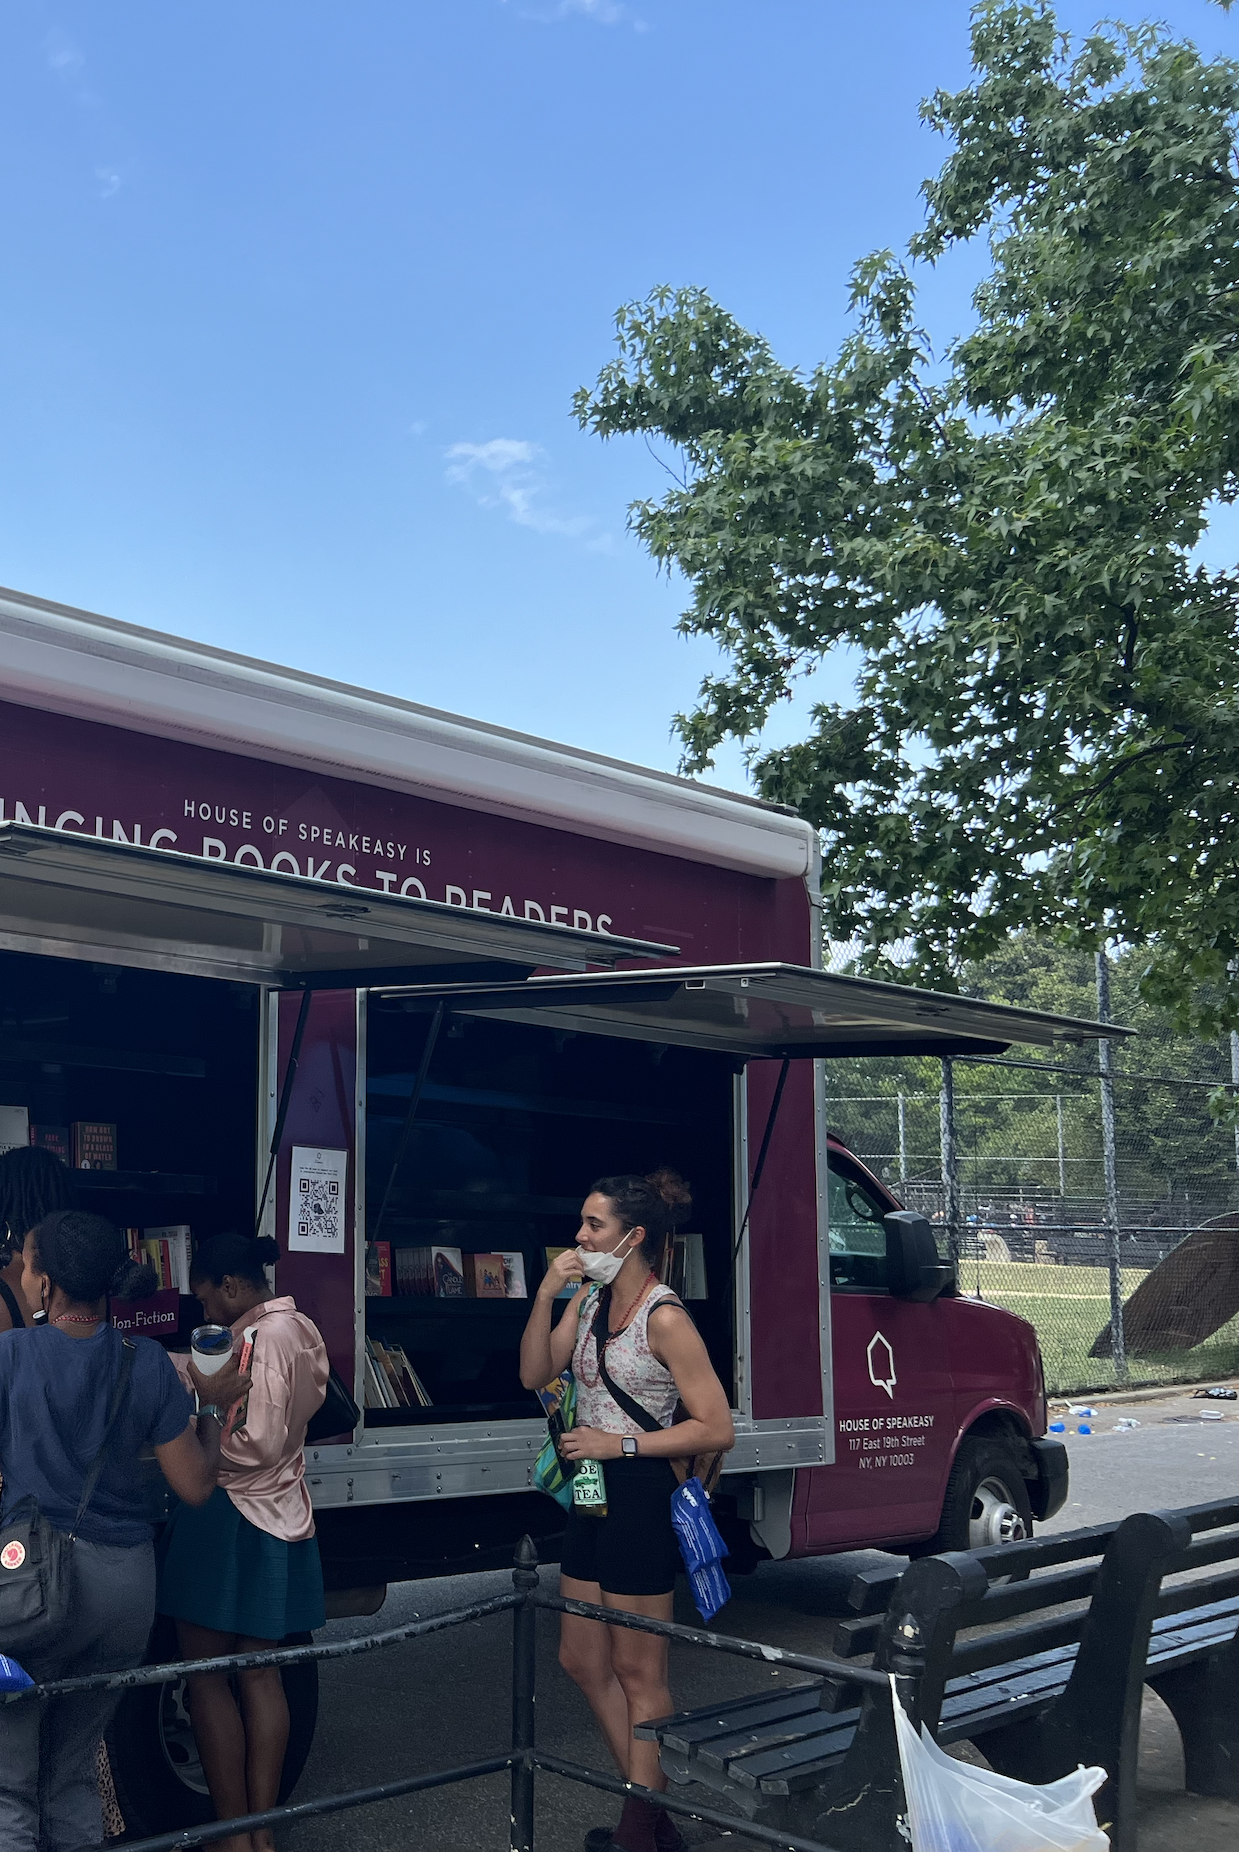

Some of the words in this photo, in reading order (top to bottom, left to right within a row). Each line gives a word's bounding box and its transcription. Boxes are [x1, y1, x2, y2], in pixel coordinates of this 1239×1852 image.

[183, 799, 252, 829] HOUSE
[261, 816, 288, 835] OF
[297, 822, 408, 862] SPEAKEASY
[414, 847, 432, 867] IS
[839, 1418, 870, 1432] HOUSE
[871, 1418, 885, 1431] OF
[885, 1415, 934, 1430] SPEAKEASY
[848, 1438, 861, 1451] 117
[862, 1437, 881, 1450] East
[882, 1436, 900, 1449] 19th
[901, 1434, 925, 1448] Street
[859, 1457, 873, 1469] NY,
[874, 1456, 889, 1467] NY
[889, 1453, 914, 1467] 10003
[579, 1465, 597, 1474] OE
[575, 1489, 600, 1499] TEA
